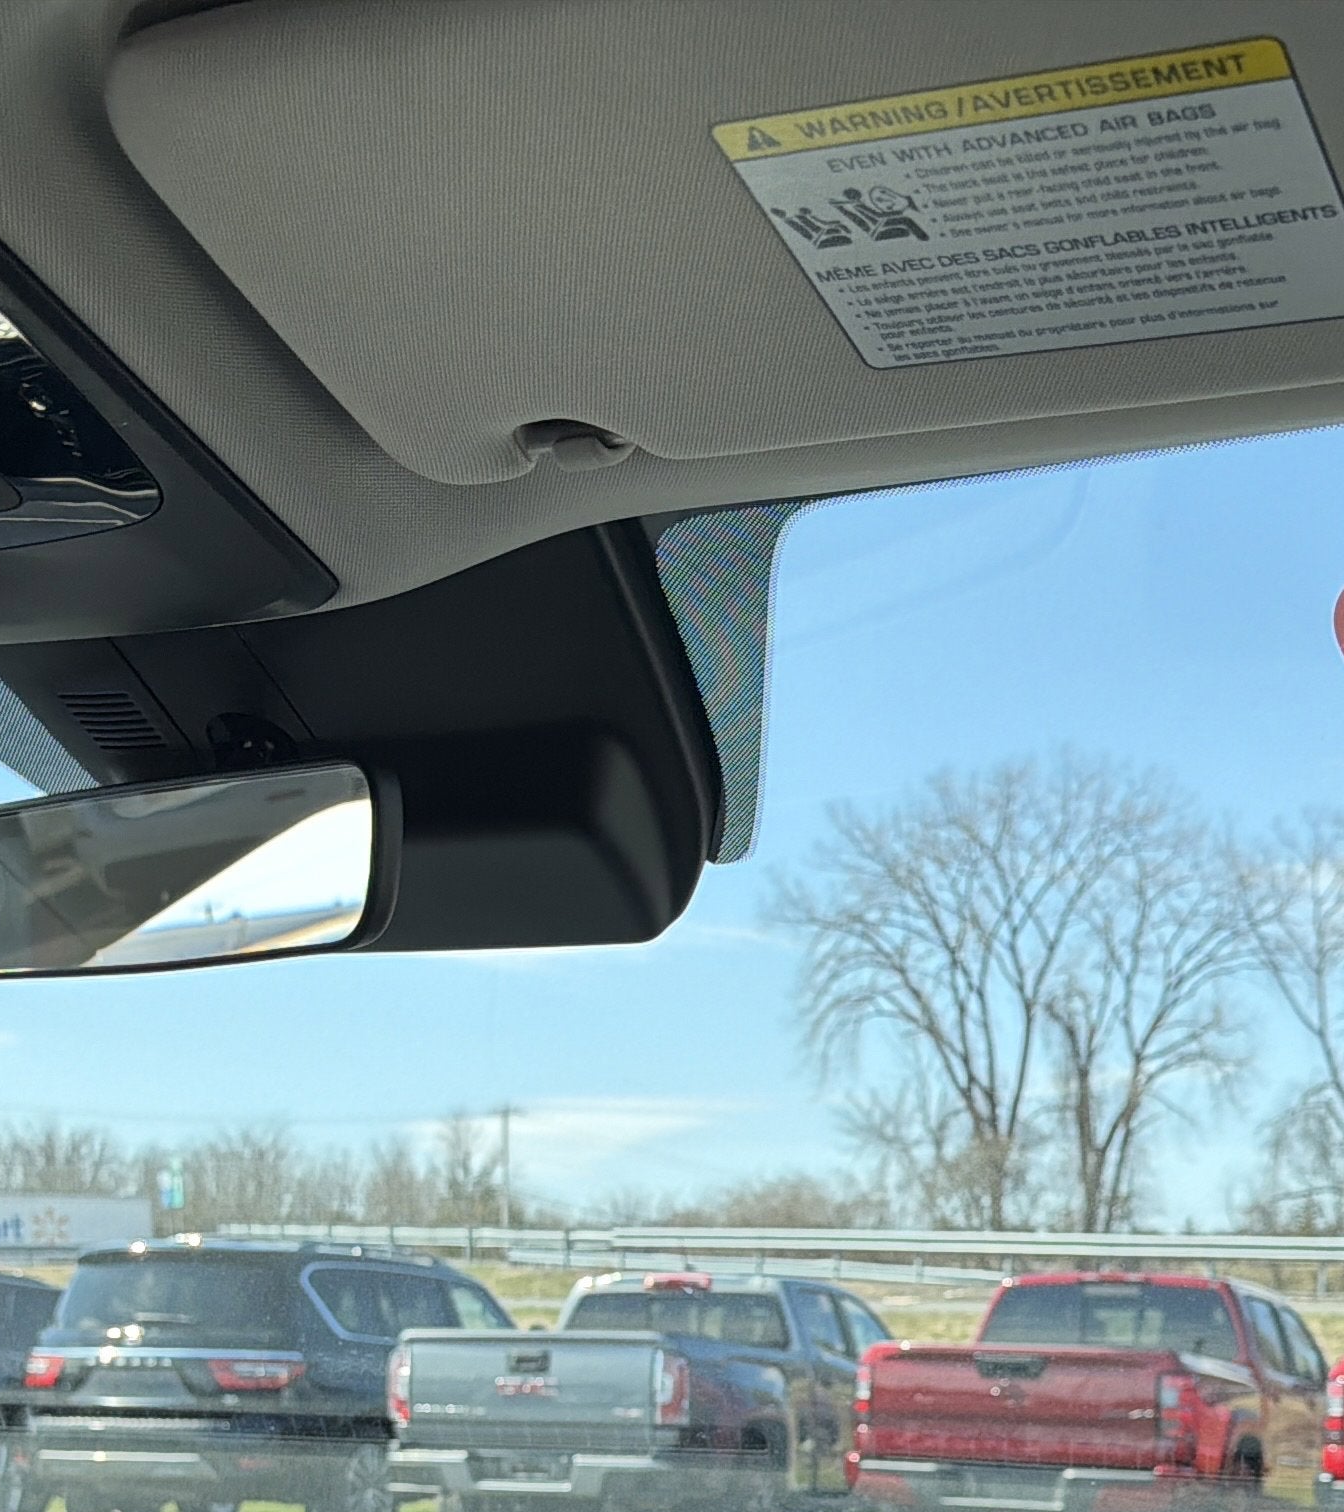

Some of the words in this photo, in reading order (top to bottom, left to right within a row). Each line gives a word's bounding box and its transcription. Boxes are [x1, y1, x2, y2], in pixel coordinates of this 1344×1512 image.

[824, 151, 888, 173] EVEN
[890, 141, 953, 163] WITH
[958, 121, 1090, 154] ADVANCED
[1095, 114, 1139, 134] AIR
[1145, 103, 1217, 127] BAGS
[877, 256, 936, 275] AVEC
[935, 250, 981, 268] DES
[980, 242, 1042, 262] SACS
[1041, 223, 1182, 254] GONFLABLES
[1182, 203, 1340, 236] INTELLIGENTS
